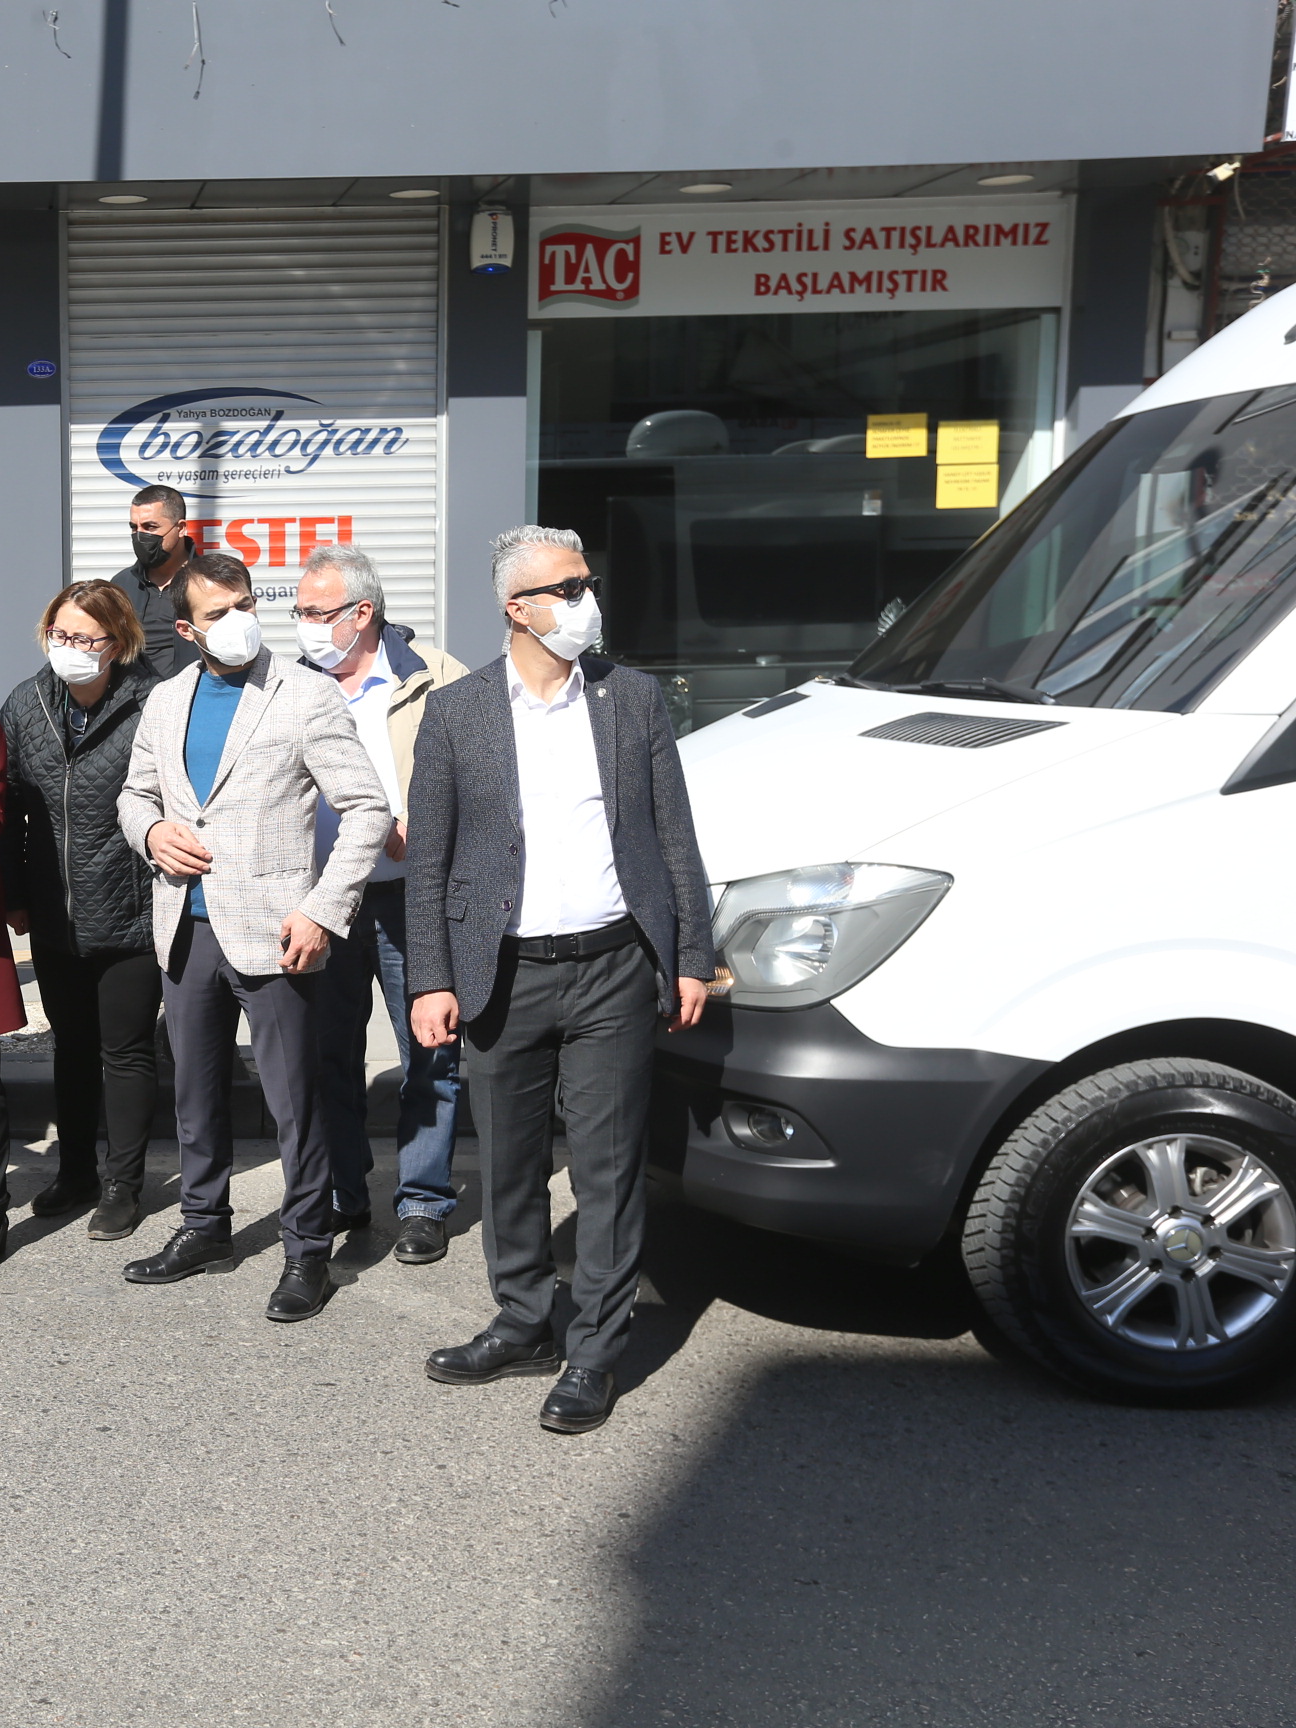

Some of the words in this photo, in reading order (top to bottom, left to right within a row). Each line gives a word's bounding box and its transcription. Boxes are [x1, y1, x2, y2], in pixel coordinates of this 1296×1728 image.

[659, 231, 696, 255] EV
[706, 221, 831, 254] TEKSTİLİ
[842, 222, 1051, 256] SATIŞLARIMIZ
[754, 269, 949, 301] BAŞLAMIŞTIR
[176, 408, 207, 420] Yahya
[210, 407, 272, 418] BOZDOĞAN
[138, 410, 410, 474] bozdoğan
[157, 471, 172, 482] ev
[177, 469, 219, 484] yaşam
[223, 464, 282, 484] gereçleri
[186, 515, 352, 567] ESTE
[253, 586, 298, 601] ogan
